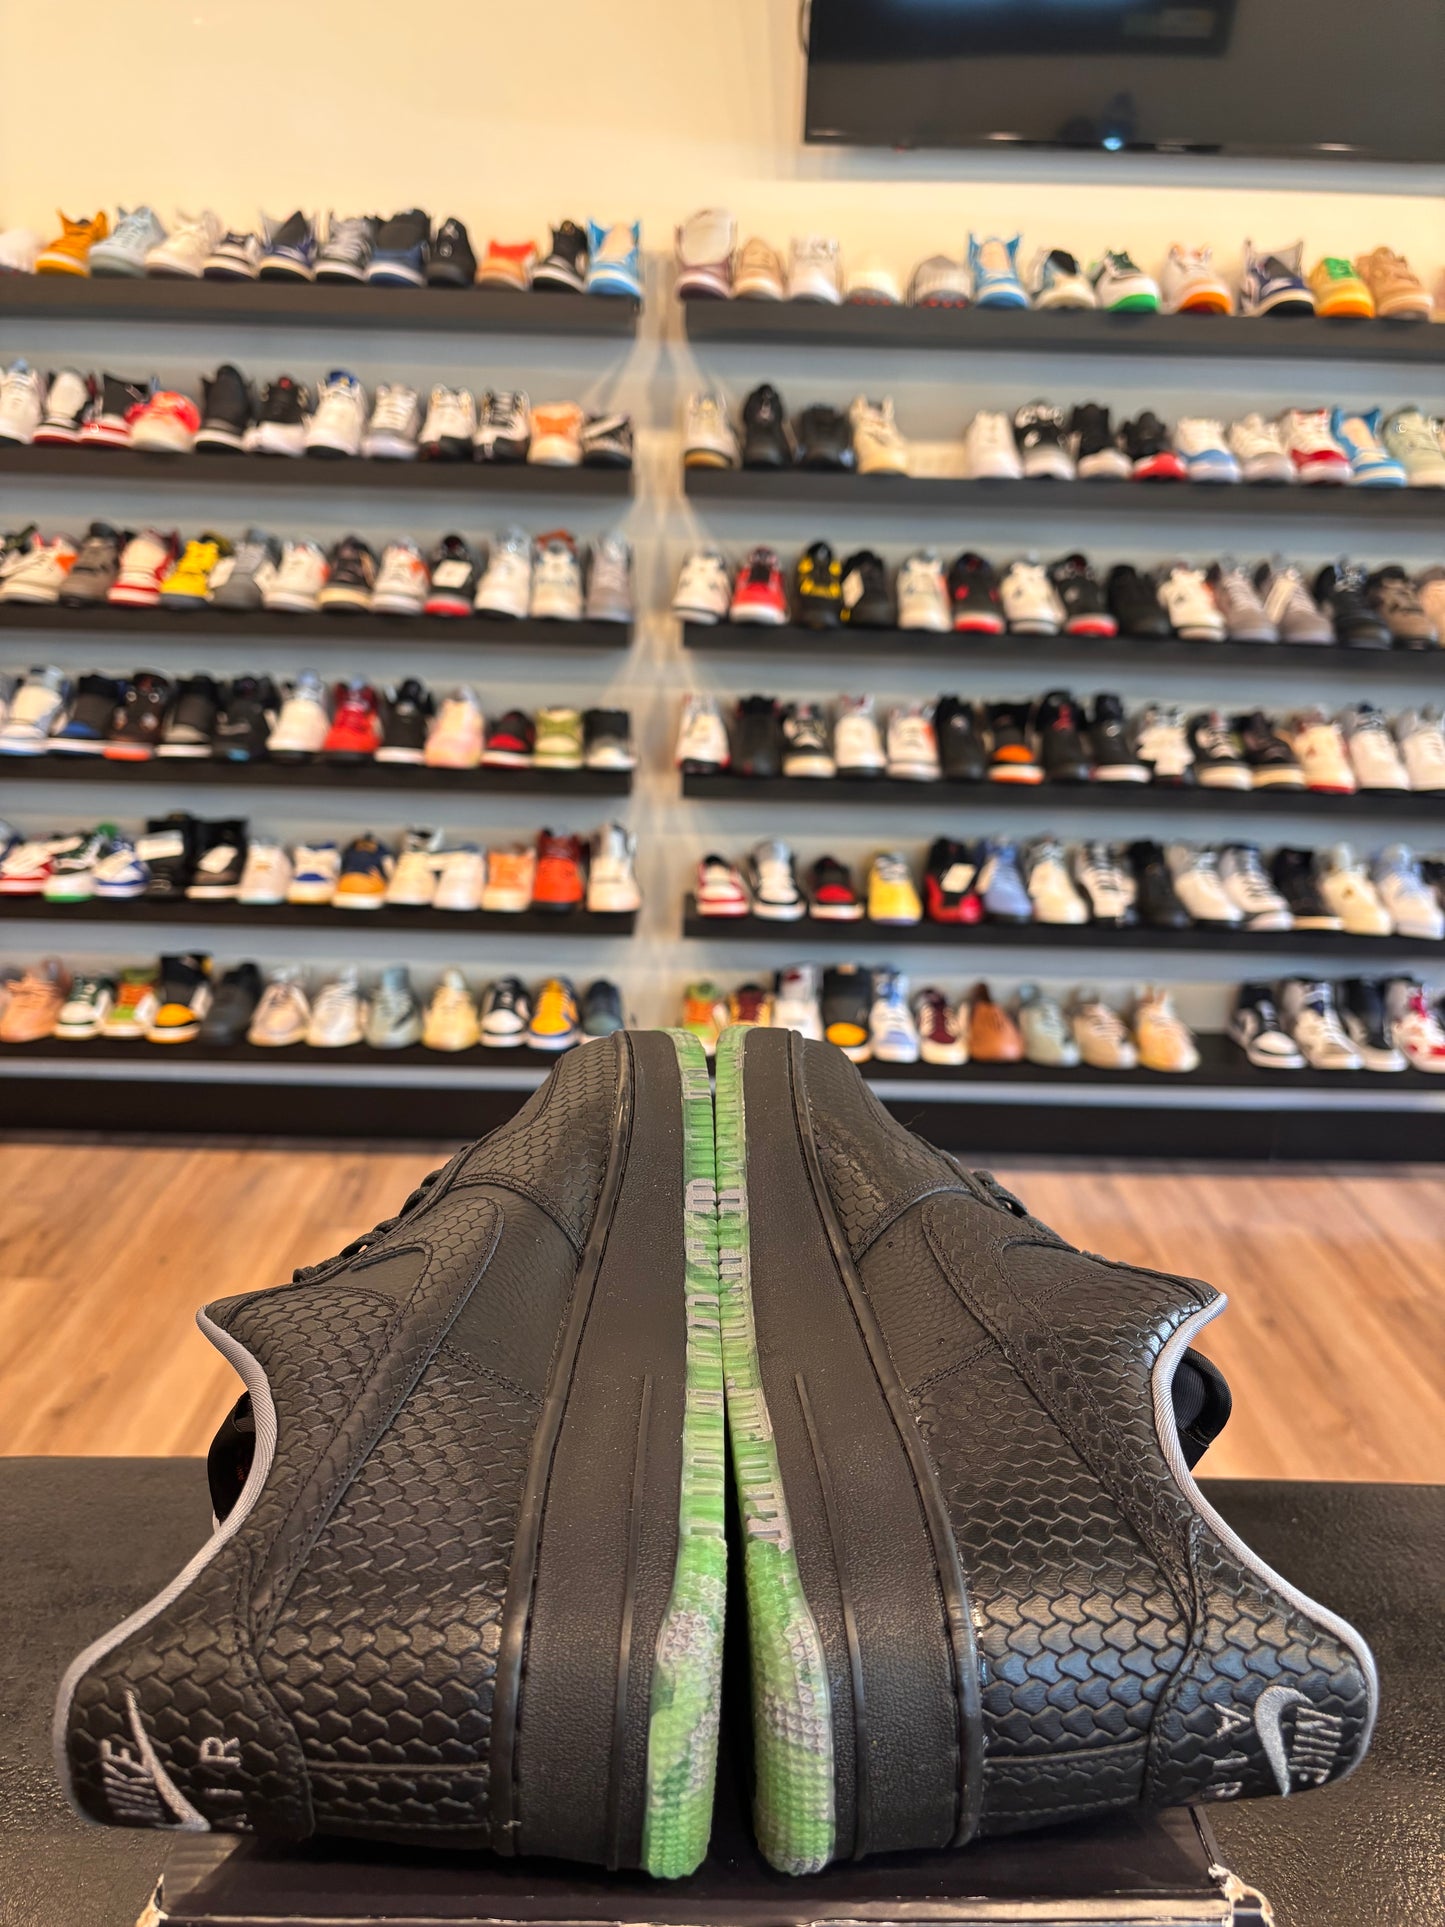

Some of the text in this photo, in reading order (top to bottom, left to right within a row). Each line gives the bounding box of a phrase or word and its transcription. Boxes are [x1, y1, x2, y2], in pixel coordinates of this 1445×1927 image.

[101, 1738, 166, 1822] NIKE
[1202, 1702, 1251, 1798] AIR
[1288, 1706, 1343, 1784] NIKE
